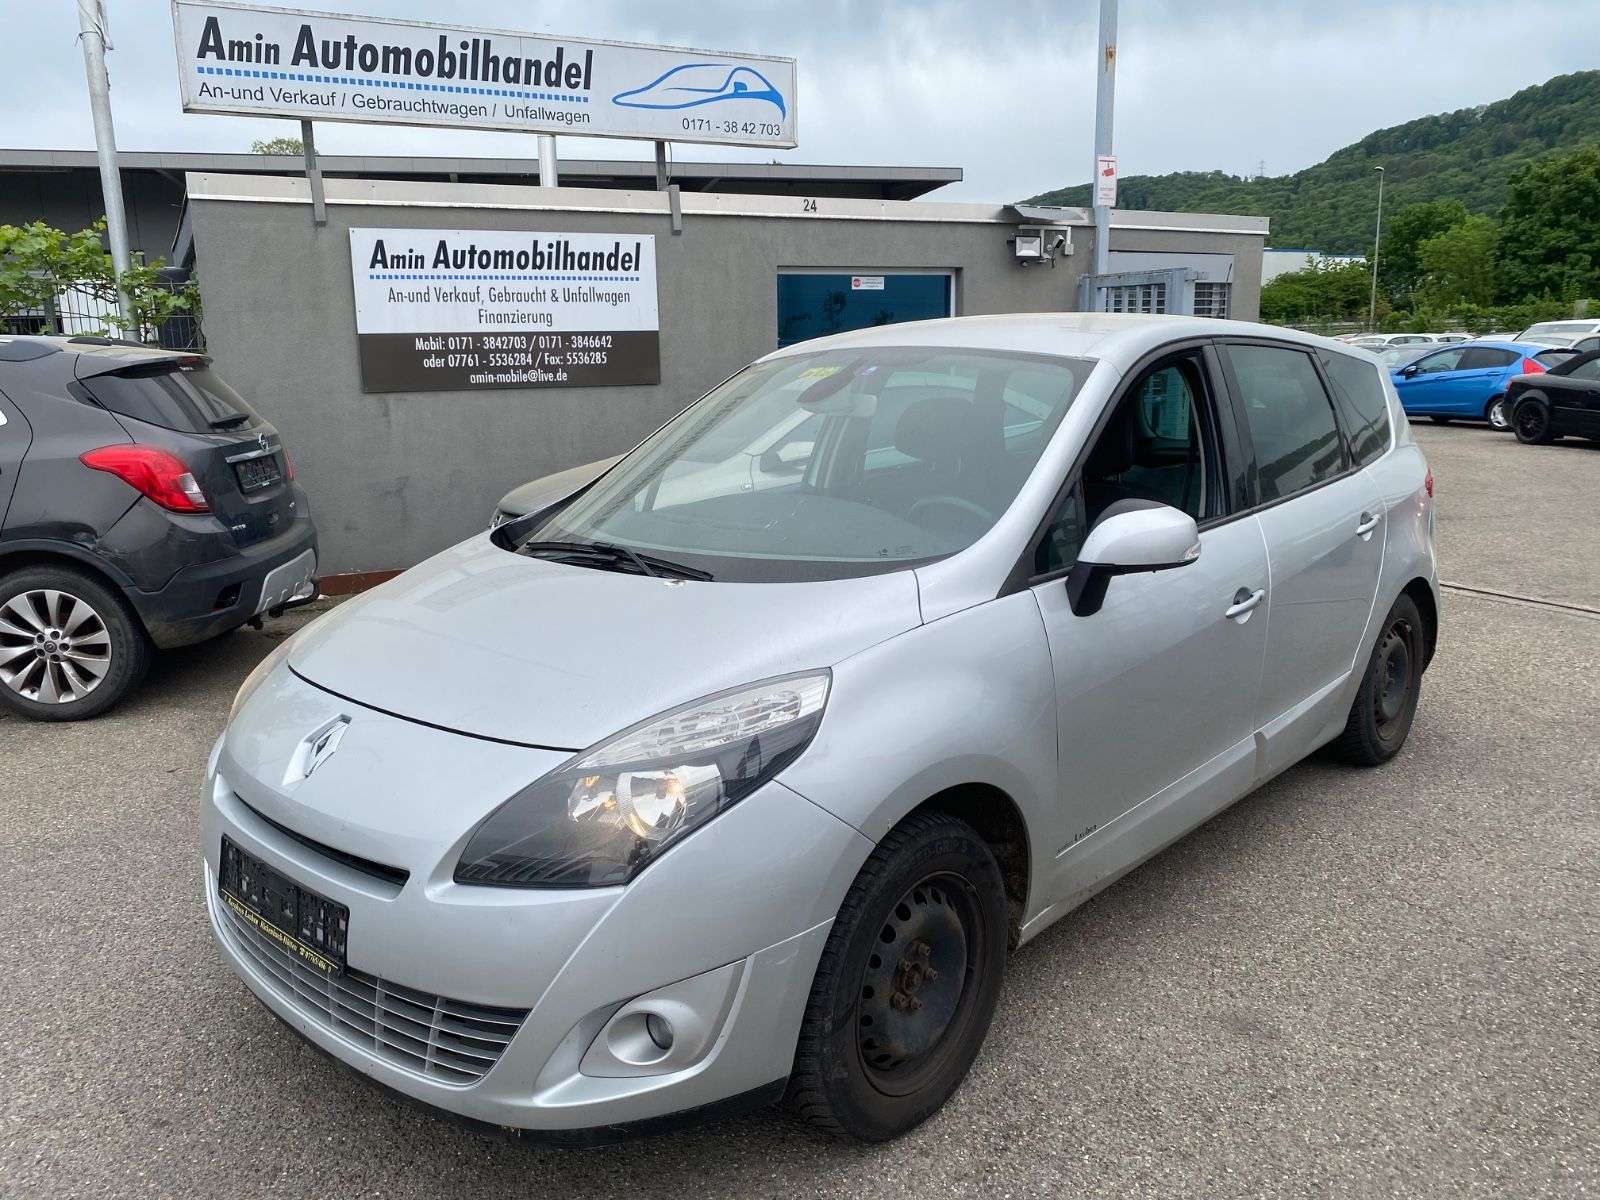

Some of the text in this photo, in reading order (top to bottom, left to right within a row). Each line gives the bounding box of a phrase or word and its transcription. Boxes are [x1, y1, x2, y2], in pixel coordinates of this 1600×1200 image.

[197, 16, 594, 90] Amin Automobilhandel
[199, 82, 264, 101] An-und
[269, 86, 336, 106] Verkauf
[352, 93, 487, 119] Gebrauchtwagen
[504, 104, 591, 125] Unfallwagen
[682, 118, 711, 131] 0171
[724, 120, 738, 134] 38
[741, 122, 756, 135] 42
[760, 123, 781, 136] 703
[803, 199, 817, 212] 24
[369, 239, 641, 272] Amin Automobilhandel
[388, 285, 631, 307] An-und Verkauf, Gebraucht & Unfallwagen
[478, 308, 553, 328] Finanzierung
[415, 336, 446, 351] Mobil:
[448, 336, 473, 350] 0171
[483, 336, 527, 350] 3842703
[539, 335, 562, 349] 0171
[571, 335, 613, 349] 3846642
[423, 353, 446, 368] oder
[448, 354, 479, 368] 07761
[489, 352, 533, 367] 5536284
[544, 352, 564, 366] Fax:
[566, 352, 608, 365] 5536285
[470, 368, 568, 384] amin-mobile@live.de
